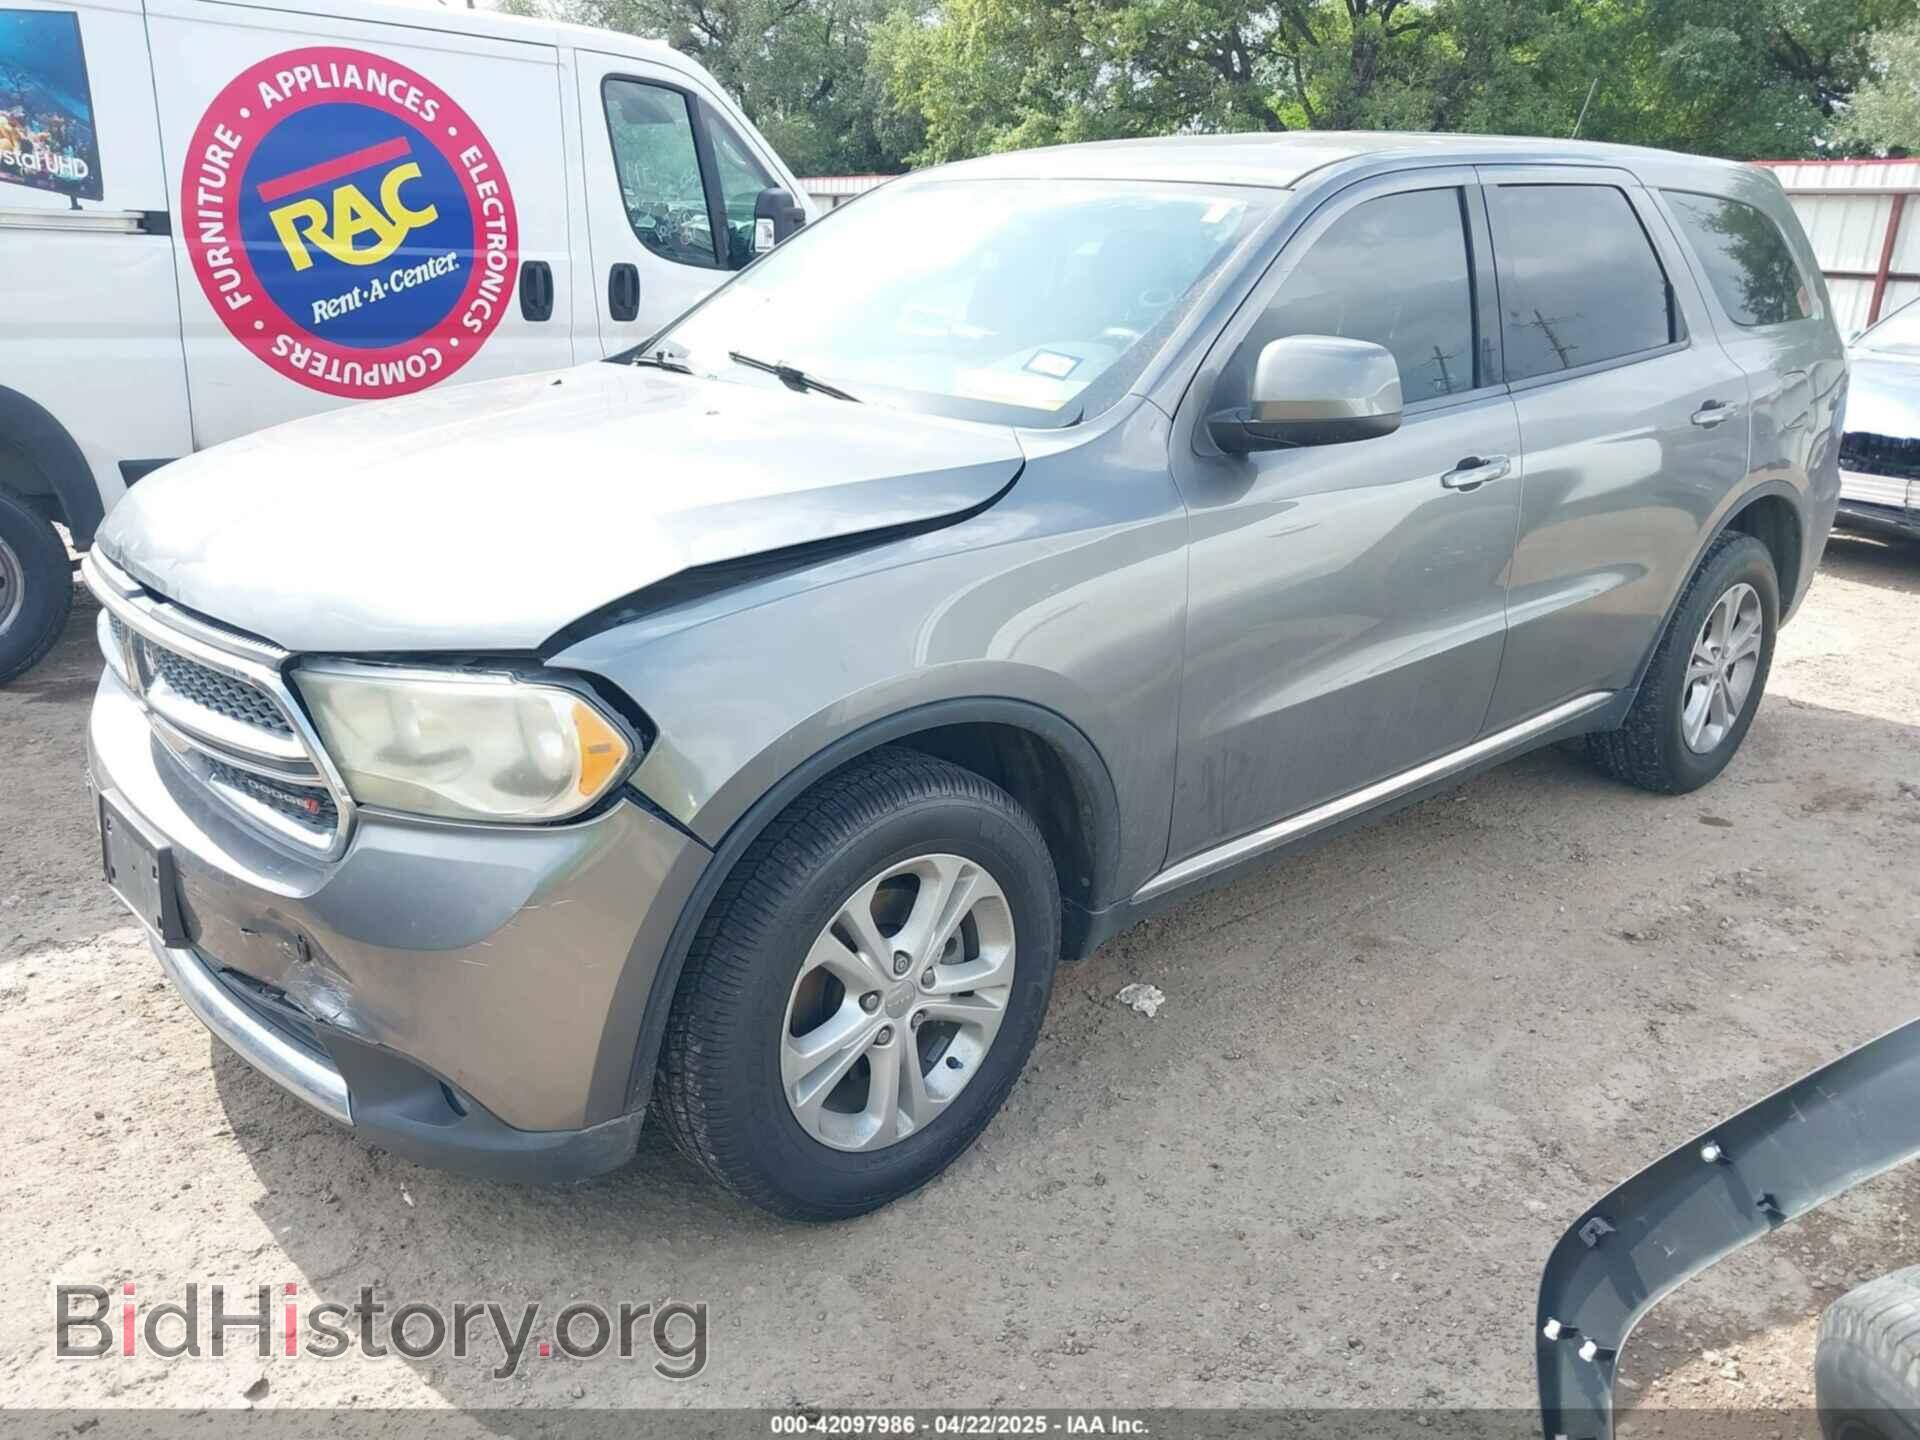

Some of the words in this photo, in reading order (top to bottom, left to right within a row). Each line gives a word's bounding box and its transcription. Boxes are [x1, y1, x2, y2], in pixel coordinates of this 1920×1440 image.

[257, 62, 441, 123] APPLIANCES
[0, 150, 42, 173] stal
[44, 153, 89, 178] UHD
[197, 123, 252, 310] FURNITURE
[269, 163, 438, 272] RAC
[460, 144, 508, 333] ELECTRONICS
[270, 333, 443, 387] COMPUTERS
